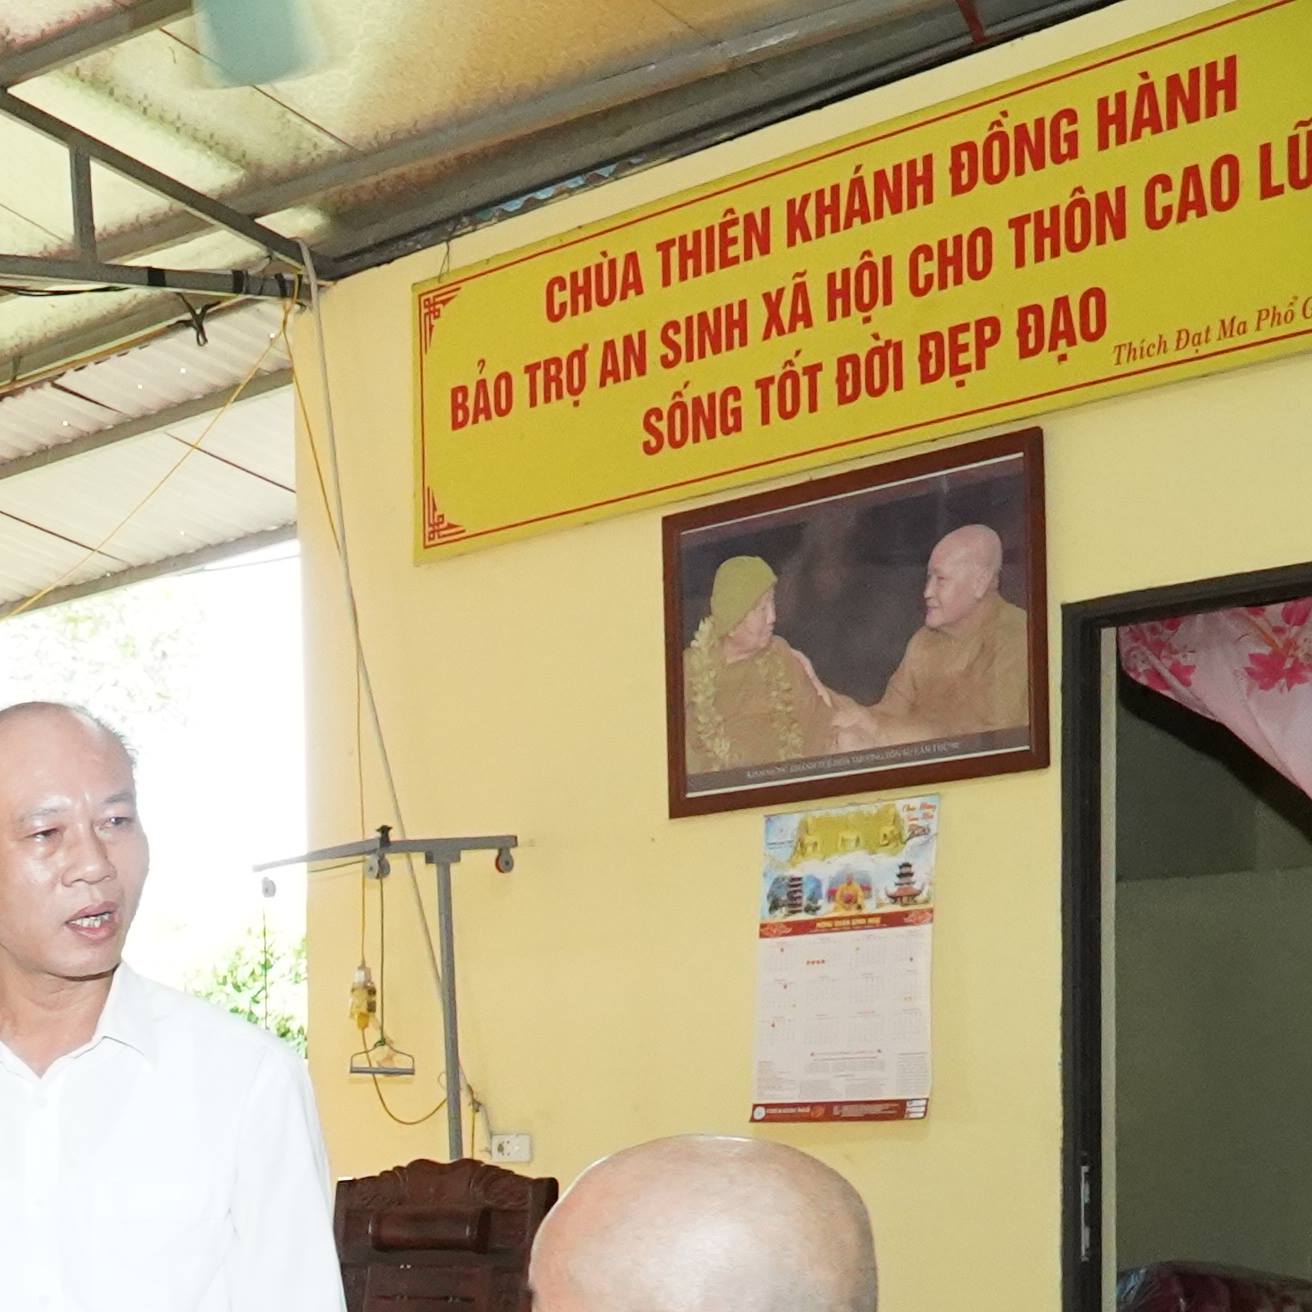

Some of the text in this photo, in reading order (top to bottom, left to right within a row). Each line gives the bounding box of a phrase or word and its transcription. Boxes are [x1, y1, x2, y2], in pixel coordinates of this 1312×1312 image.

[450, 357, 515, 431] BẢO
[523, 343, 590, 408] TRỢ
[599, 330, 648, 386] AN
[660, 299, 748, 369] SINH
[762, 270, 814, 342] XÃ
[826, 251, 894, 323] HỘI
[908, 226, 993, 298] CHO
[1008, 185, 1127, 268] THÔN
[1145, 154, 1241, 230] CAO
[545, 54, 1238, 323] CHÙA THIÊN KHÁNH ĐỒNG HÀNH
[641, 286, 1109, 456] SỐNG TỐT ĐỜI ĐẸP ĐẠO
[1114, 334, 1168, 366] Thích
[1176, 325, 1210, 353] Đạt
[1217, 316, 1247, 341] Ma
[1255, 296, 1298, 332] Phổ
